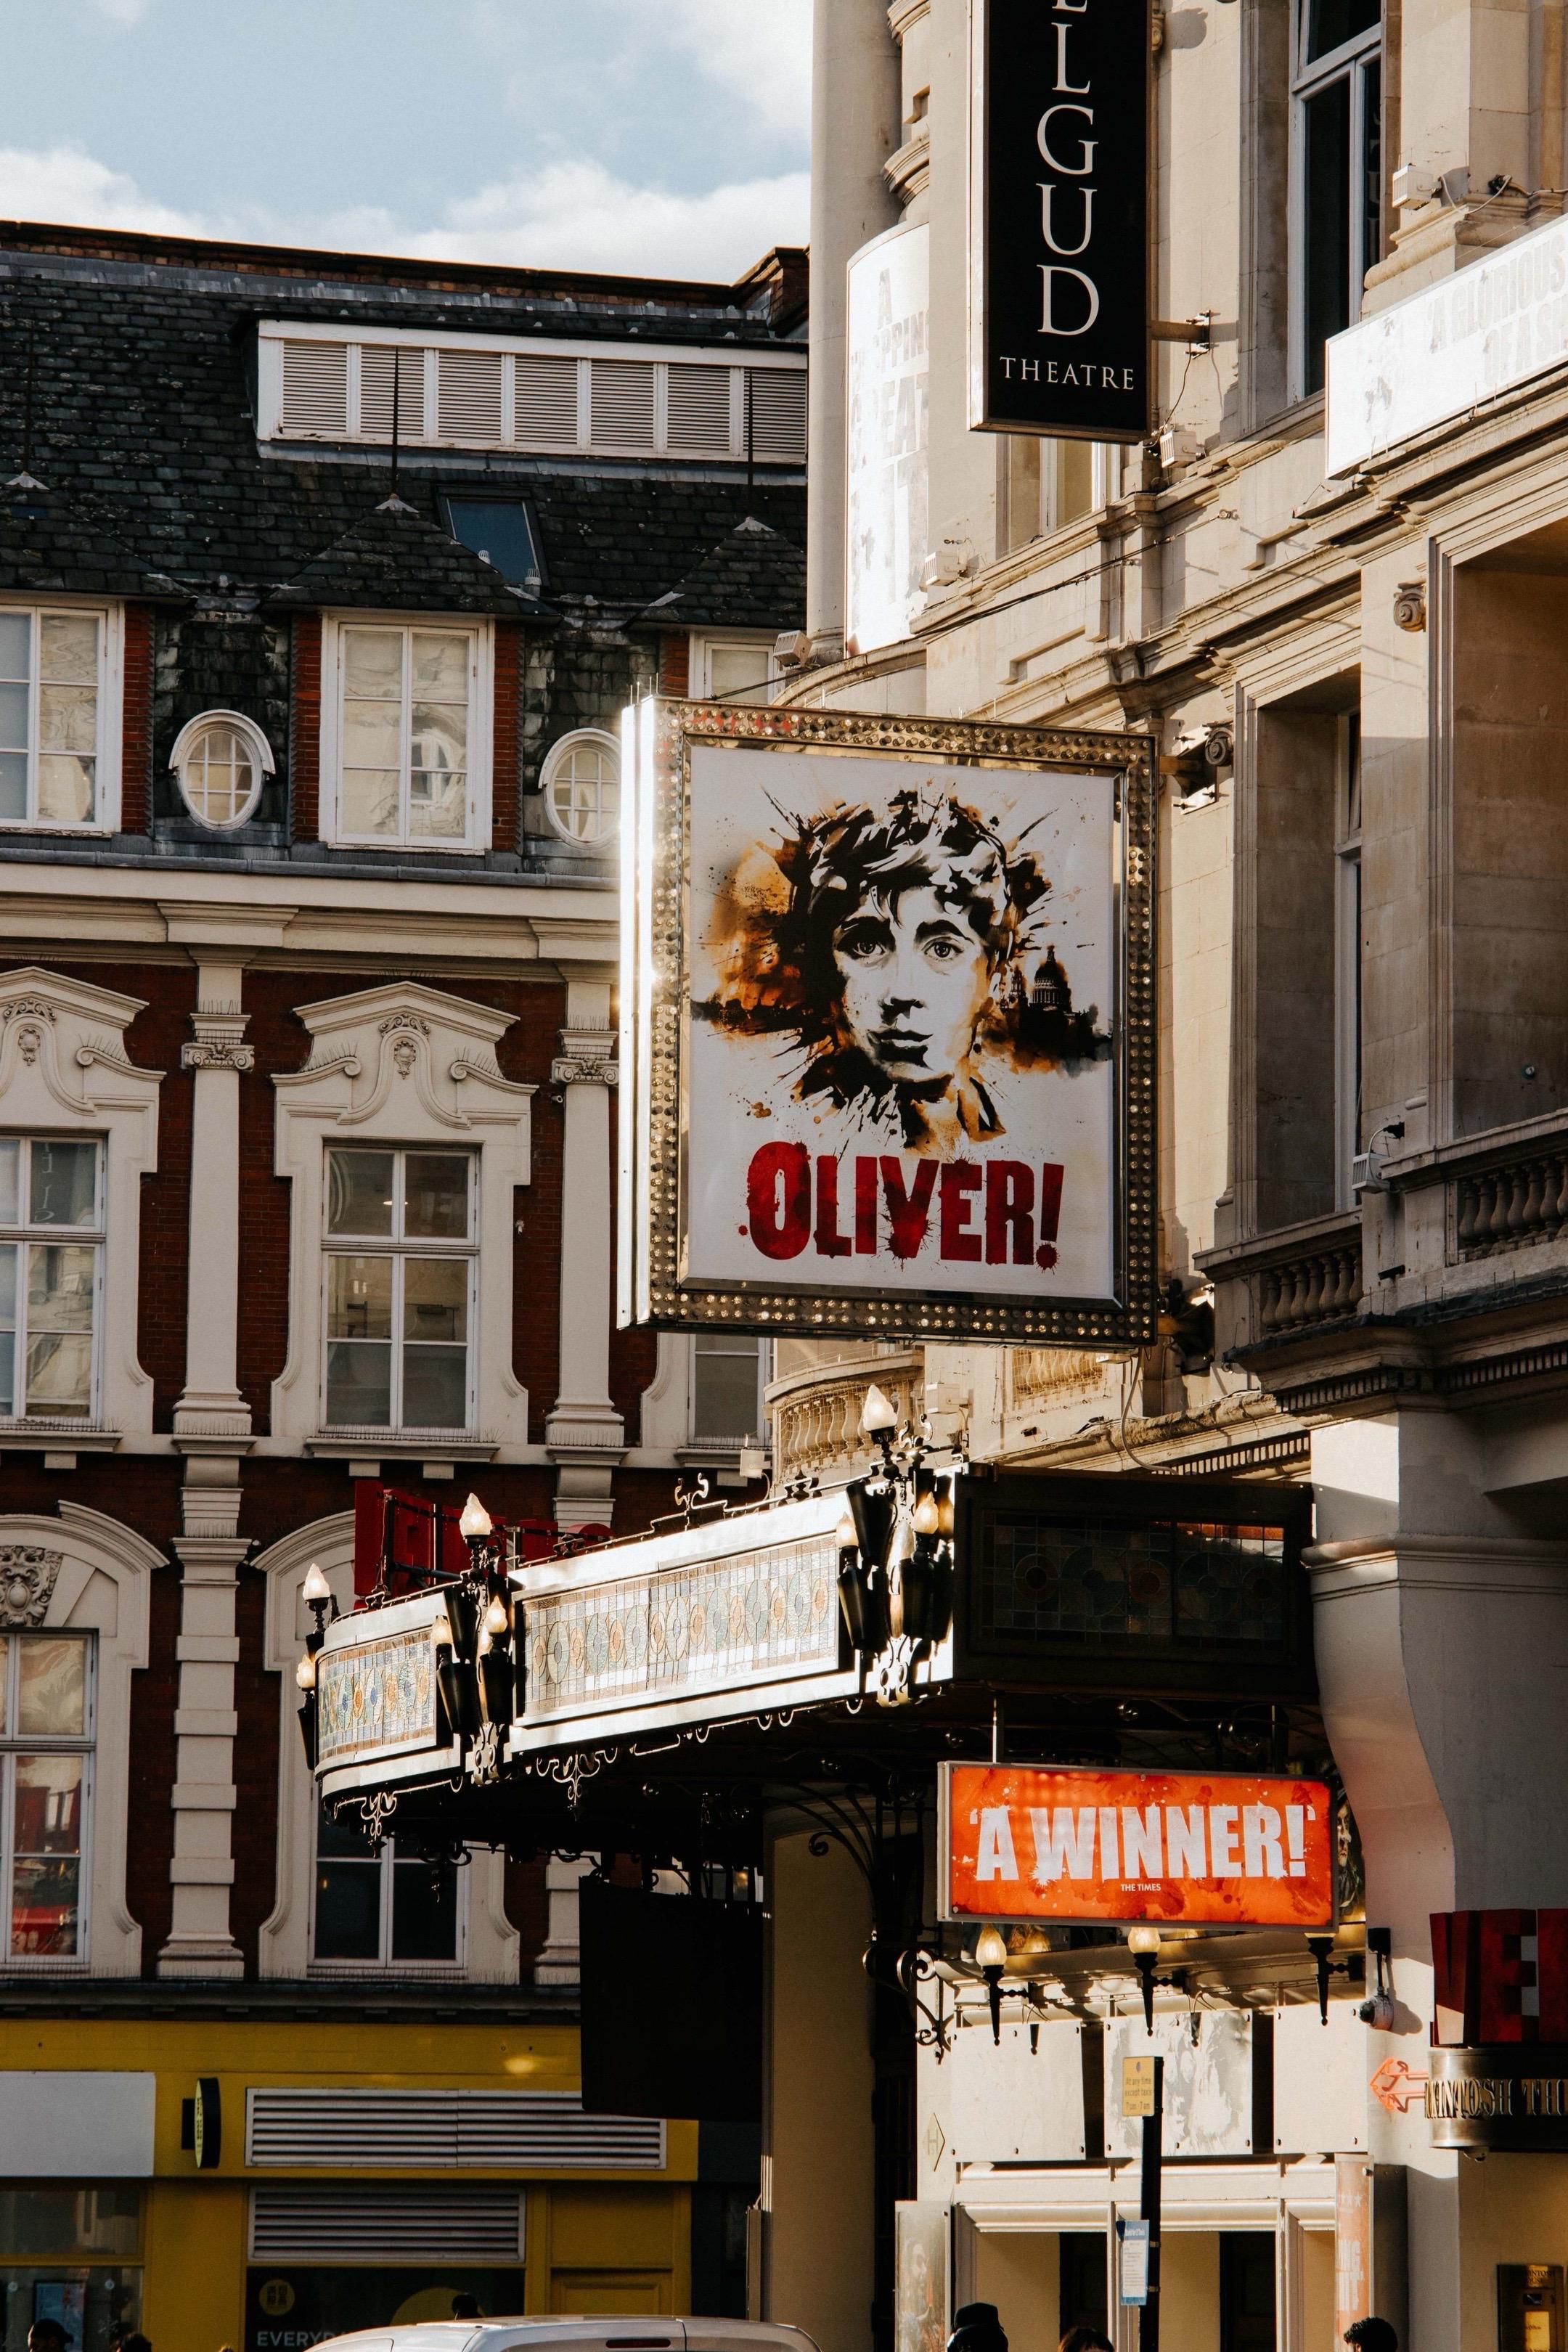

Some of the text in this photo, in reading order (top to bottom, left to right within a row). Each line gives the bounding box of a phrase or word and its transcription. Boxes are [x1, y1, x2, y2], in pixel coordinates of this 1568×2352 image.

[1037, 0, 1100, 336] LGUD
[1000, 356, 1134, 391] THEATRE
[747, 1141, 1064, 1273] OLIVER!
[1030, 1803, 1316, 1882] WINNER!’
[1138, 1883, 1161, 1892] TIMES
[257, 2331, 346, 2346] EVERY
